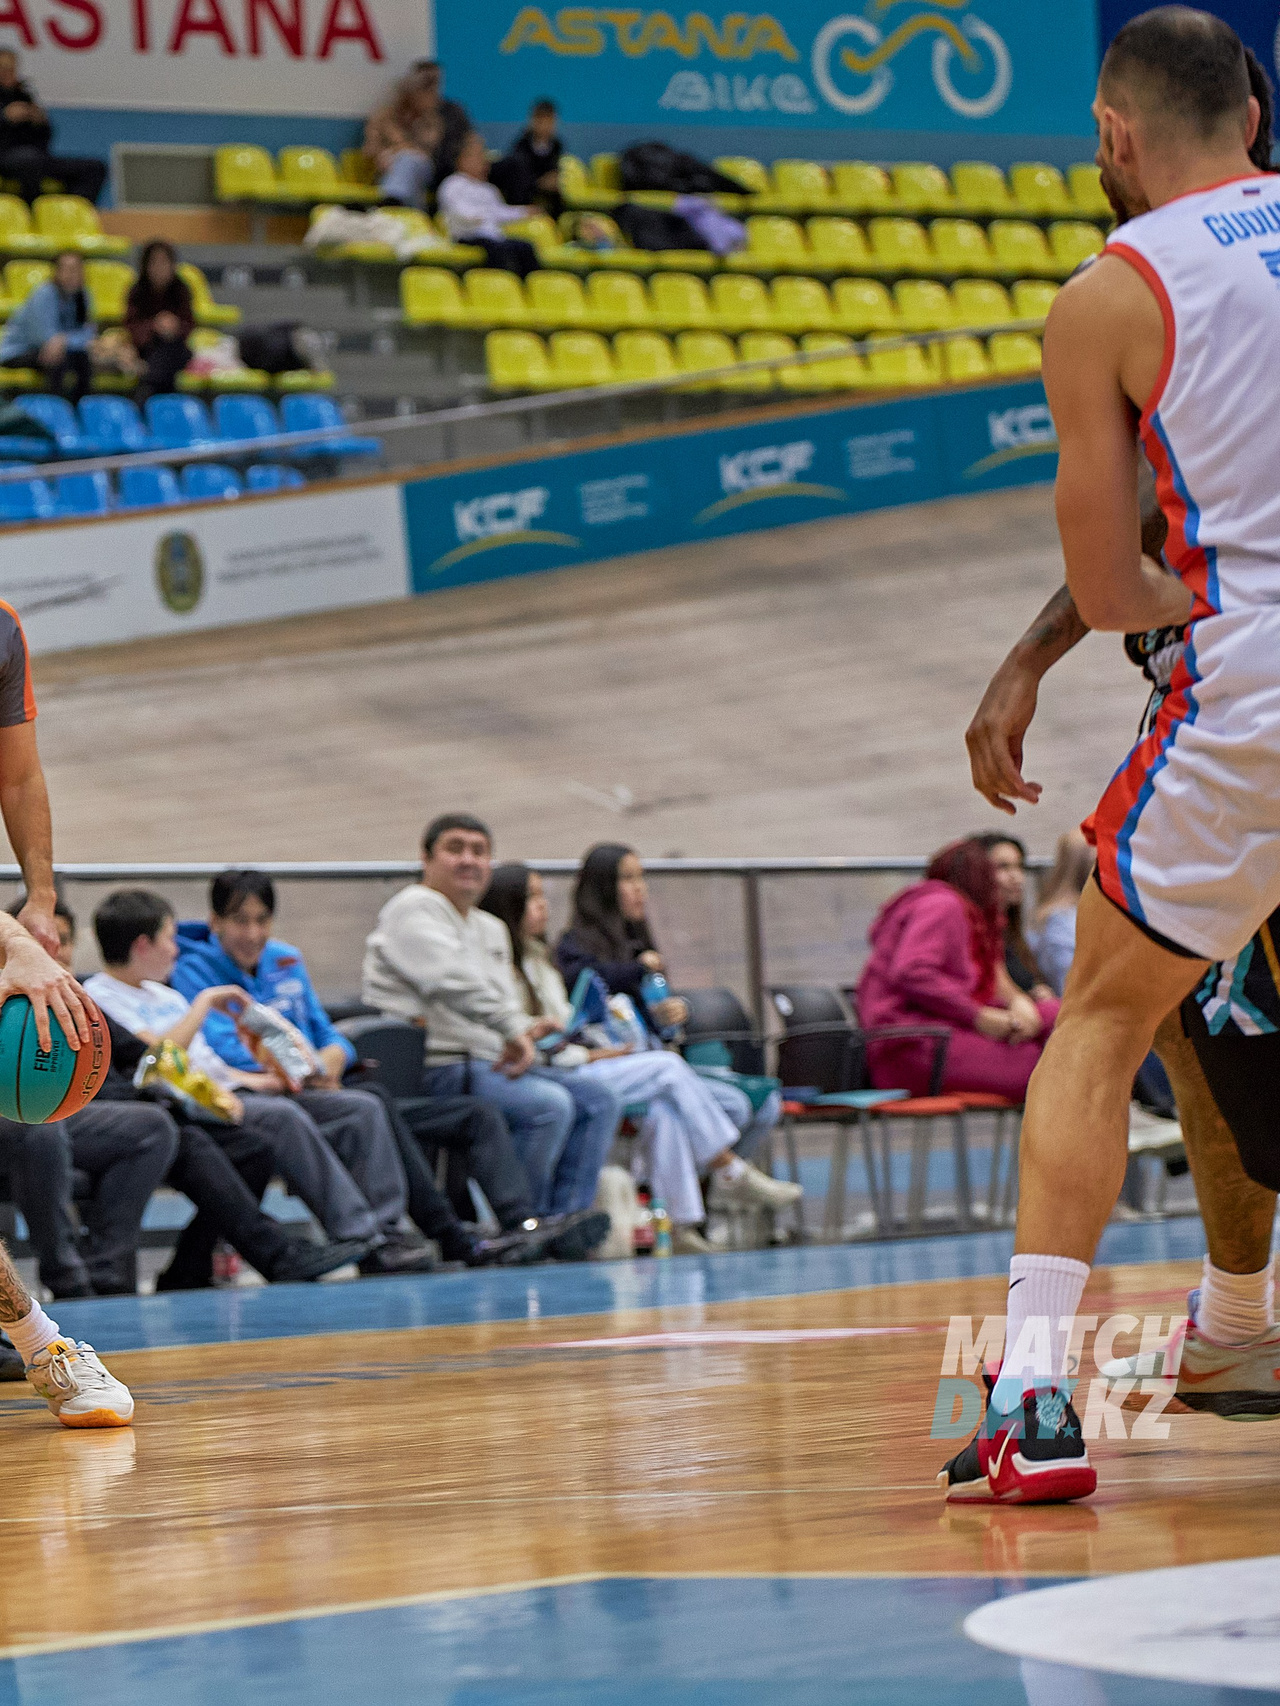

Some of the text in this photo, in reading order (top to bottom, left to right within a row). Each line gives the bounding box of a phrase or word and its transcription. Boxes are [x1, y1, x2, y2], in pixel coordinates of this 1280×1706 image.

[498, 8, 800, 62] ASTANA
[1202, 199, 1280, 247] GUDU
[34, 1040, 51, 1072] FIB
